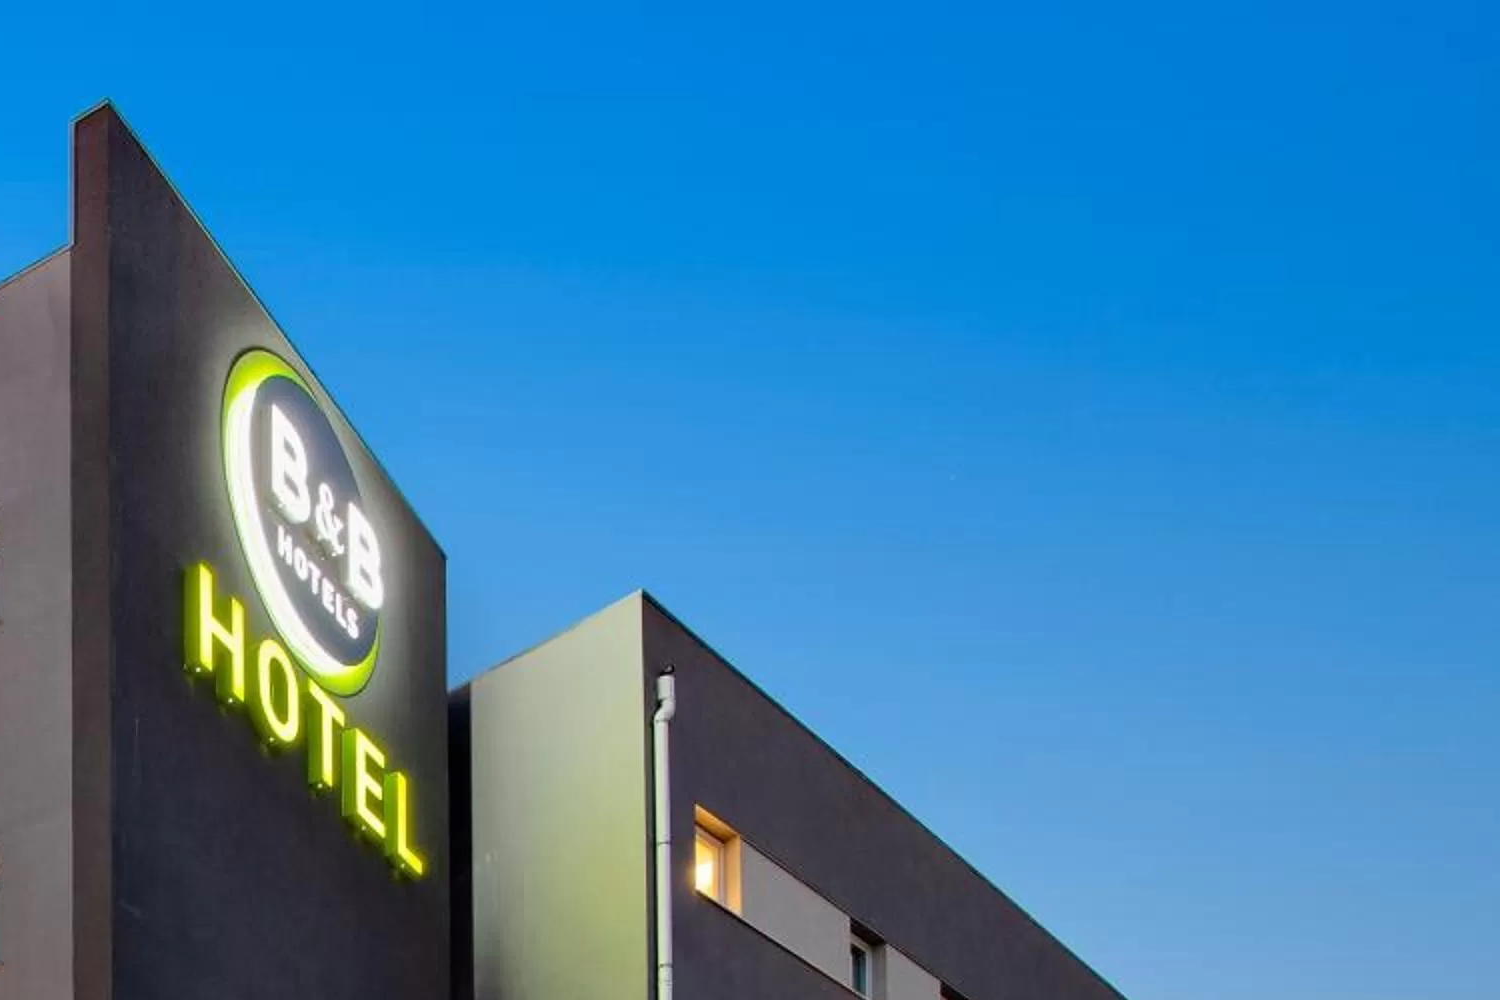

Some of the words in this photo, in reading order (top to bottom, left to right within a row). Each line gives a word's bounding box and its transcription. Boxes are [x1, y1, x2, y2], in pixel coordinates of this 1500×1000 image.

[270, 404, 384, 609] B&B
[276, 524, 360, 640] HOTELS
[185, 562, 423, 876] HOTEL
